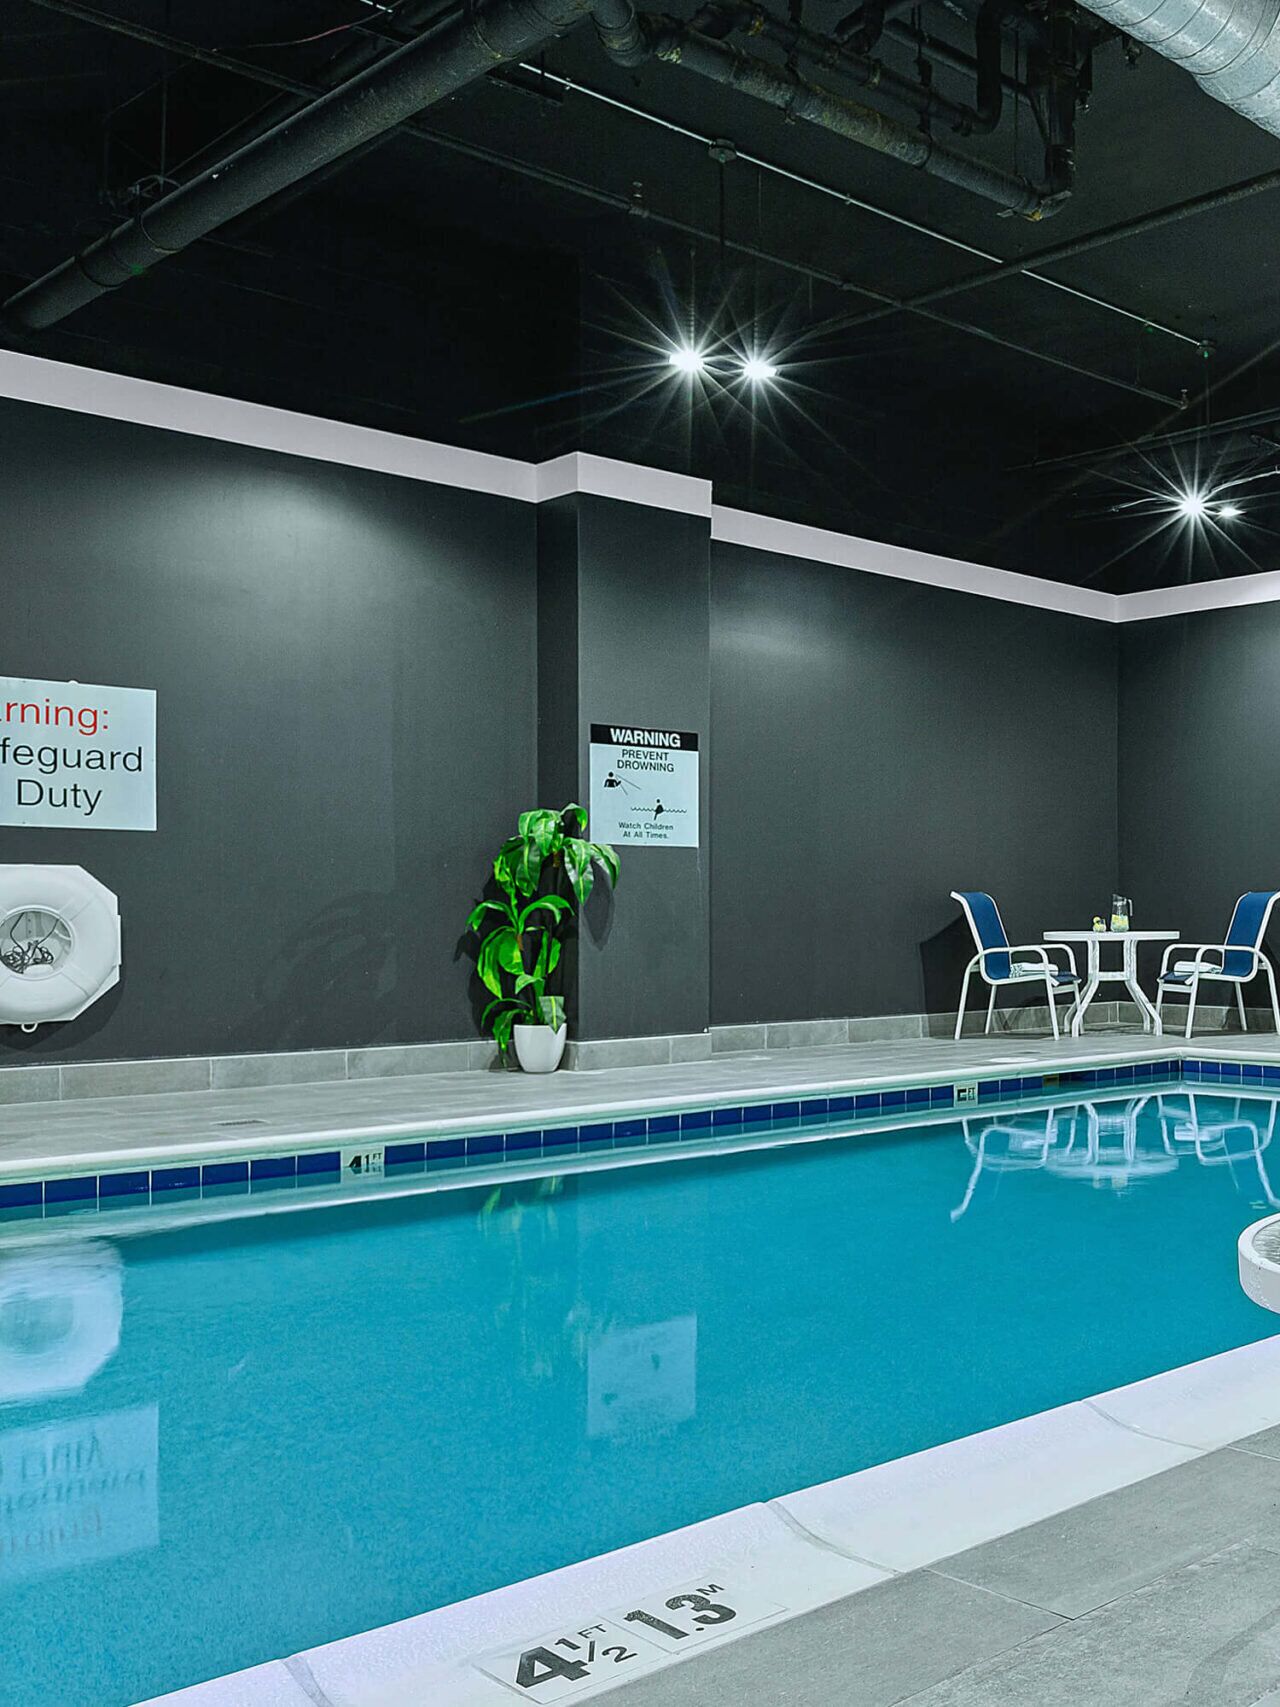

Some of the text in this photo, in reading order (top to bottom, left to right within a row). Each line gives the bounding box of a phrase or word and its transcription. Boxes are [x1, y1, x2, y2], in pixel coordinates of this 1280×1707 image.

[0, 698, 109, 736] rning:
[610, 728, 681, 747] WARNING
[0, 737, 143, 775] feguard
[622, 749, 669, 761] PREVENT
[617, 760, 674, 772] DROWNING
[17, 778, 102, 816] Duty
[618, 821, 674, 830] Watch Children
[623, 830, 631, 838] At
[633, 831, 643, 839] All
[696, 1583, 725, 1596] M
[578, 1623, 607, 1639] FT
